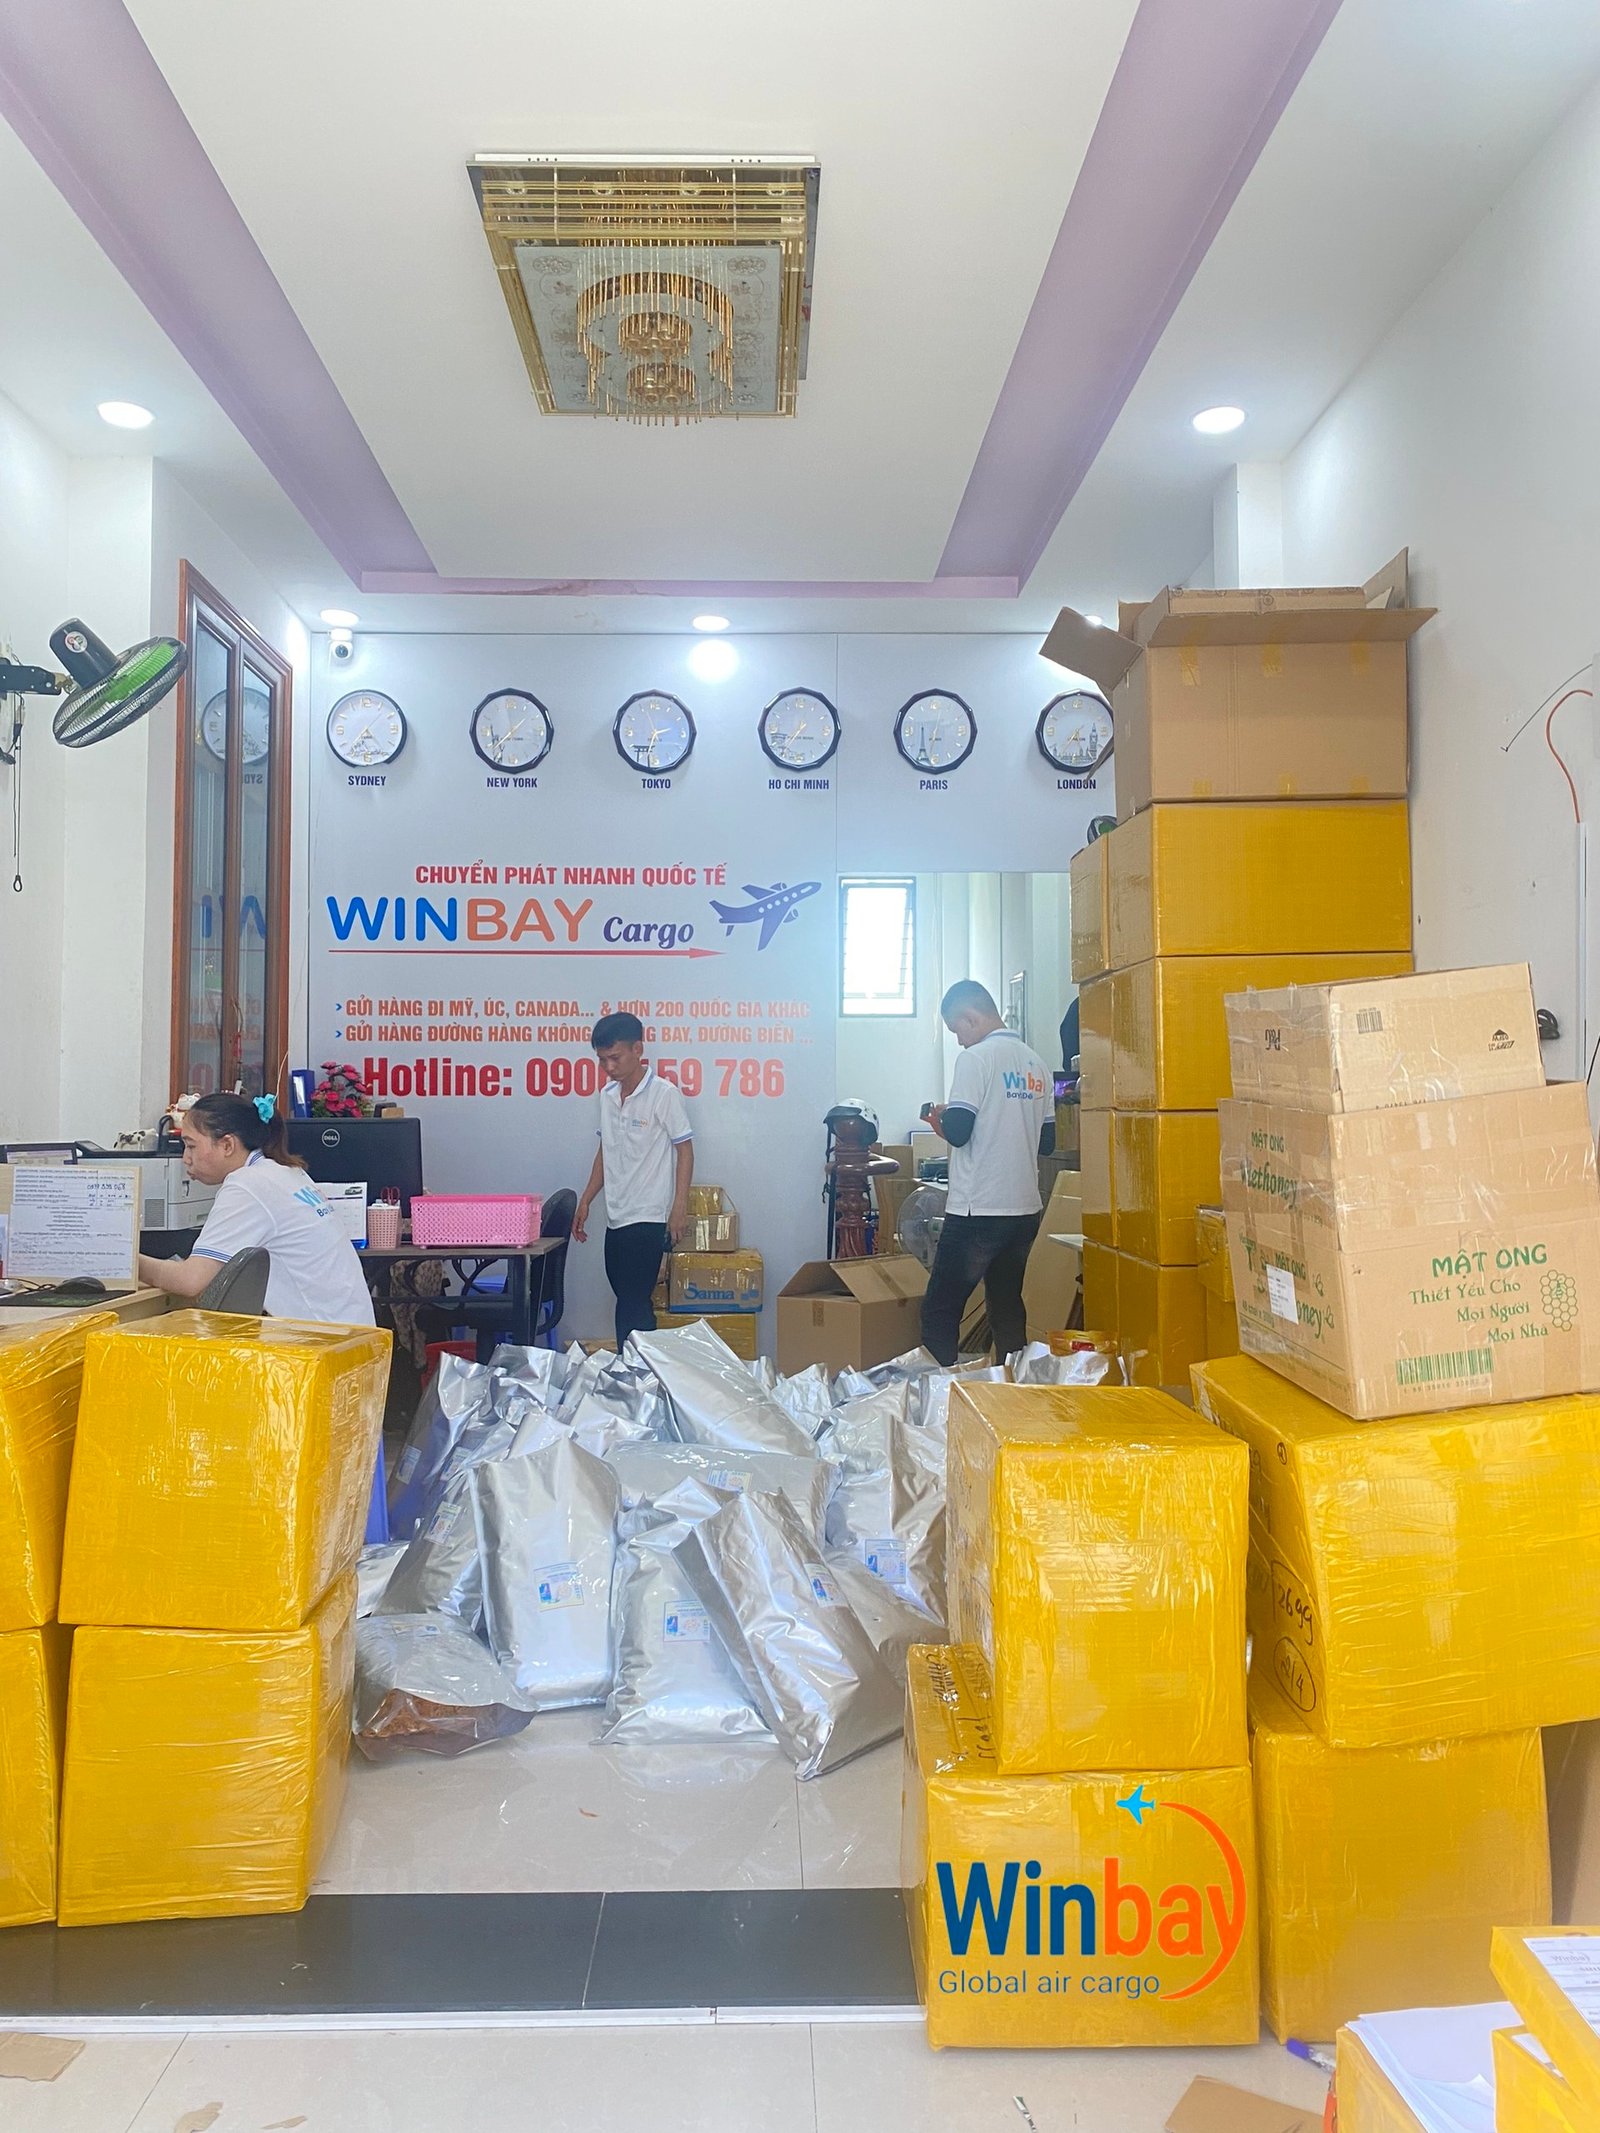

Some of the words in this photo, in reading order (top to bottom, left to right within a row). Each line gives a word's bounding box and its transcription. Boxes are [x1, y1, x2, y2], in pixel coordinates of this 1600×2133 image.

[348, 775, 386, 787] SYDNEY
[486, 777, 510, 788] NEW
[512, 777, 538, 788] YORK
[641, 778, 671, 789] TOKYO
[768, 779, 782, 790] HO
[784, 779, 801, 790] CHI
[803, 779, 830, 790] MINH
[919, 779, 948, 790] PARIS
[1057, 779, 1097, 790] LONDON
[415, 859, 498, 884] CHUYỂN
[504, 863, 557, 885] PHÁT
[564, 867, 635, 885] NHANH
[642, 861, 696, 887] QUỐC
[703, 862, 728, 886] TẾ
[326, 896, 593, 942] WINBAY
[603, 916, 694, 949] Cargo
[346, 994, 373, 1017] GỬI
[378, 996, 423, 1017] HÀNG
[428, 999, 444, 1017] ĐI
[450, 997, 479, 1018] MỸ,
[484, 997, 510, 1019] ÚC,
[515, 1000, 594, 1017] CANADA...
[618, 999, 650, 1017] HƠN
[655, 1001, 684, 1017] 200
[689, 996, 731, 1019] QUỐC
[736, 1001, 763, 1017] GIA
[768, 999, 811, 1018] KHÁC
[346, 1020, 373, 1042] GỬI
[378, 1022, 423, 1042] HÀNG
[428, 1021, 483, 1042] ĐƯỜNG
[488, 1023, 532, 1042] HÀNG
[537, 1023, 591, 1042] KHÔNG
[661, 1026, 692, 1044] BAY,
[698, 1023, 753, 1043] ĐƯỜNG
[363, 1057, 512, 1097] Hotline:
[715, 1058, 784, 1098] 786
[1432, 1249, 1487, 1279] MẬT
[1496, 1244, 1547, 1269] ONG
[1408, 1288, 1451, 1305] Thiết
[1490, 1279, 1521, 1294] Cho
[1457, 1307, 1485, 1323] Mọi
[1490, 1302, 1530, 1323] Người
[1488, 1328, 1515, 1343] Mọi
[1520, 1323, 1549, 1339] Nhà
